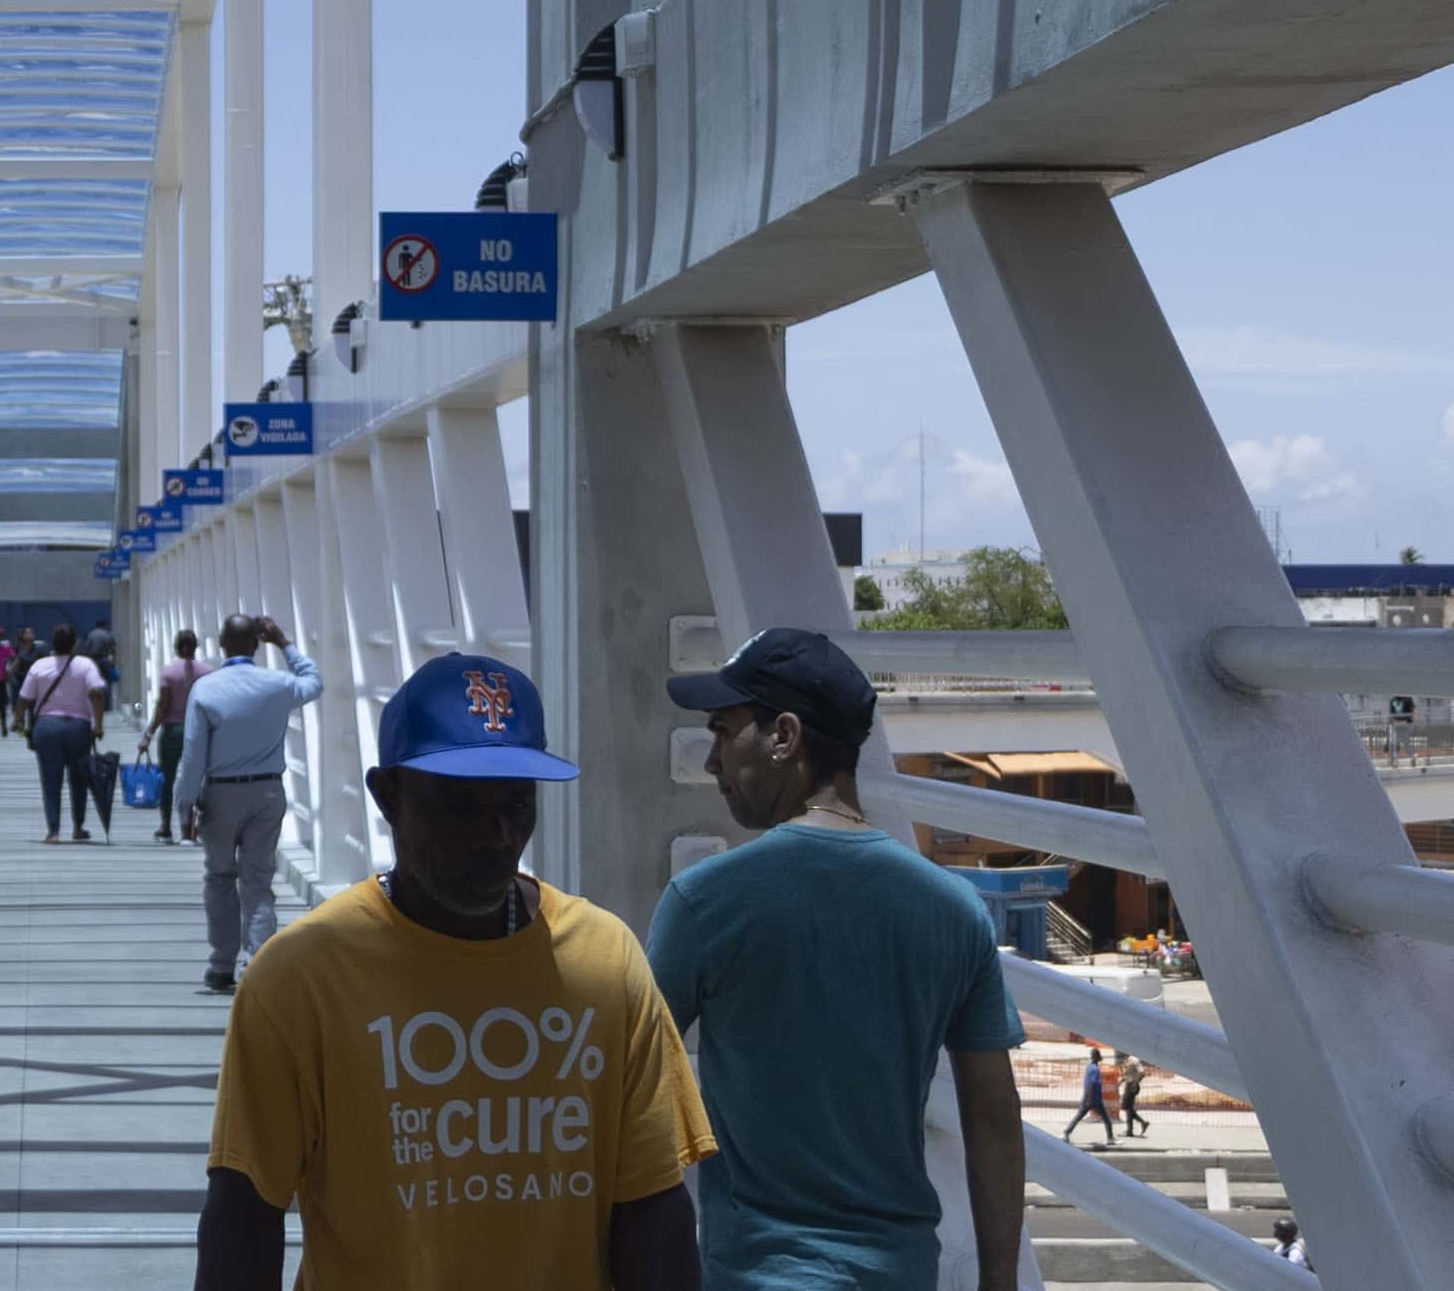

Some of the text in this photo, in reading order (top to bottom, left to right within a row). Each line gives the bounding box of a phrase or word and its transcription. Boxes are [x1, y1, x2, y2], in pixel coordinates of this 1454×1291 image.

[479, 239, 512, 262] NO
[453, 270, 547, 293] BASURA
[366, 1006, 605, 1090] 100%
[390, 1101, 432, 1134] for
[436, 1094, 591, 1158] cure
[392, 1136, 434, 1165] the
[397, 1170, 595, 1211] VELOSANO
